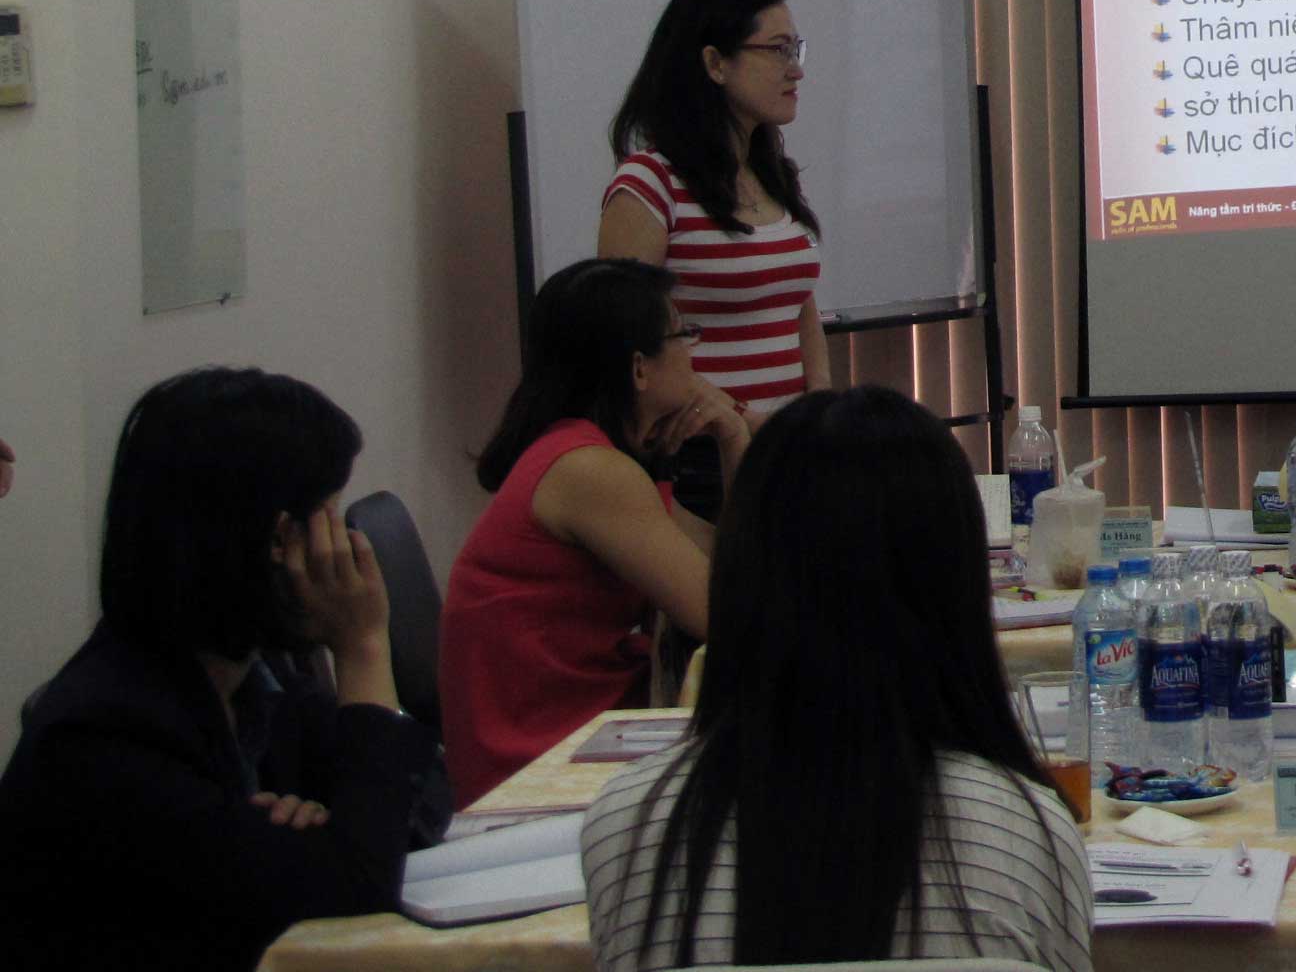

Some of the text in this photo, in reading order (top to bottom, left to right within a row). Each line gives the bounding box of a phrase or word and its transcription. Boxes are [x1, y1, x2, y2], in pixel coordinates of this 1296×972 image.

[1179, 18, 1258, 43] Thâm
[1183, 54, 1240, 80] Quê
[1228, 88, 1294, 116] thích
[1186, 128, 1243, 157] Mục
[1110, 196, 1177, 227] SAM
